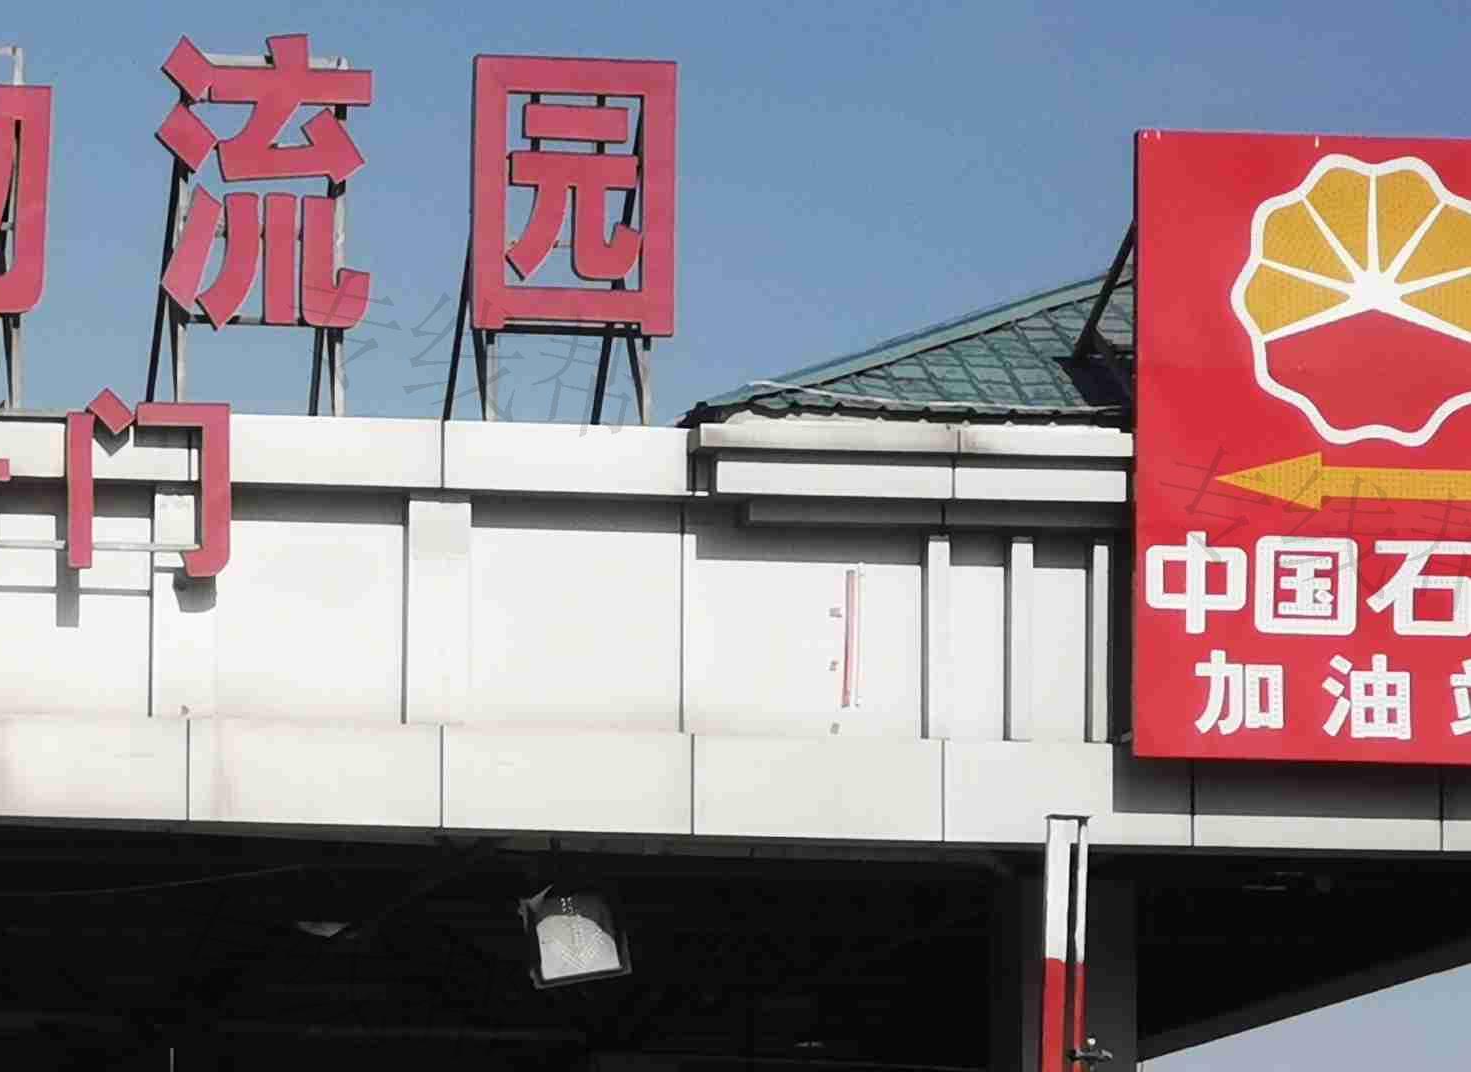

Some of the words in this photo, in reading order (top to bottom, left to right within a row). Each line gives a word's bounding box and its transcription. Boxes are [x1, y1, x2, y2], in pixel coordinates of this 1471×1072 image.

[1145, 530, 1471, 636] 中国石
[1195, 650, 1471, 740] 加油
